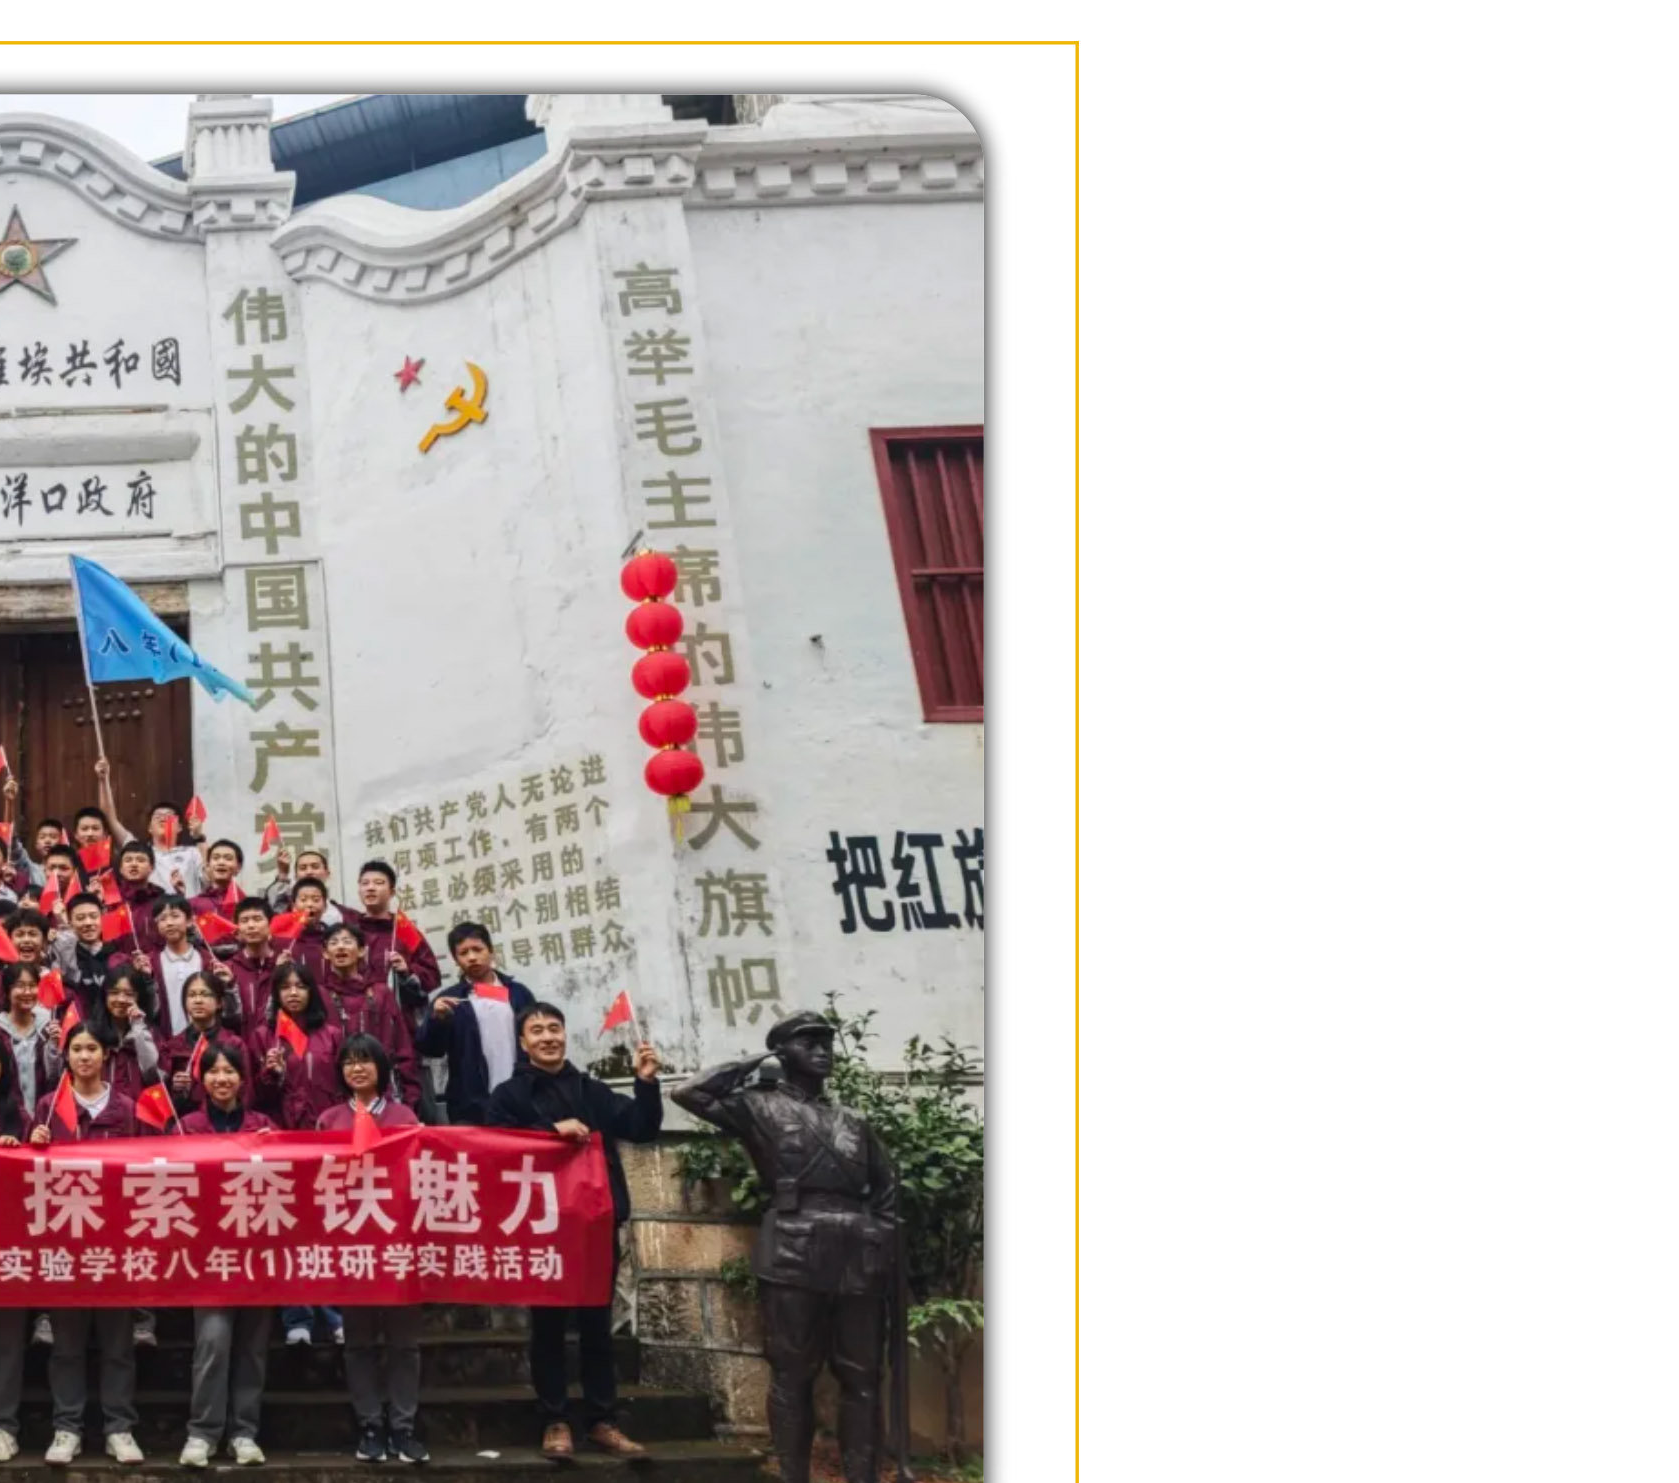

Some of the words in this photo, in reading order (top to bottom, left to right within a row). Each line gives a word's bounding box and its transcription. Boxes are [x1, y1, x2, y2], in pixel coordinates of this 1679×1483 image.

[365, 753, 607, 848] 我们共产党人无论进
[22, 1150, 561, 1239] 探索森铁魅力
